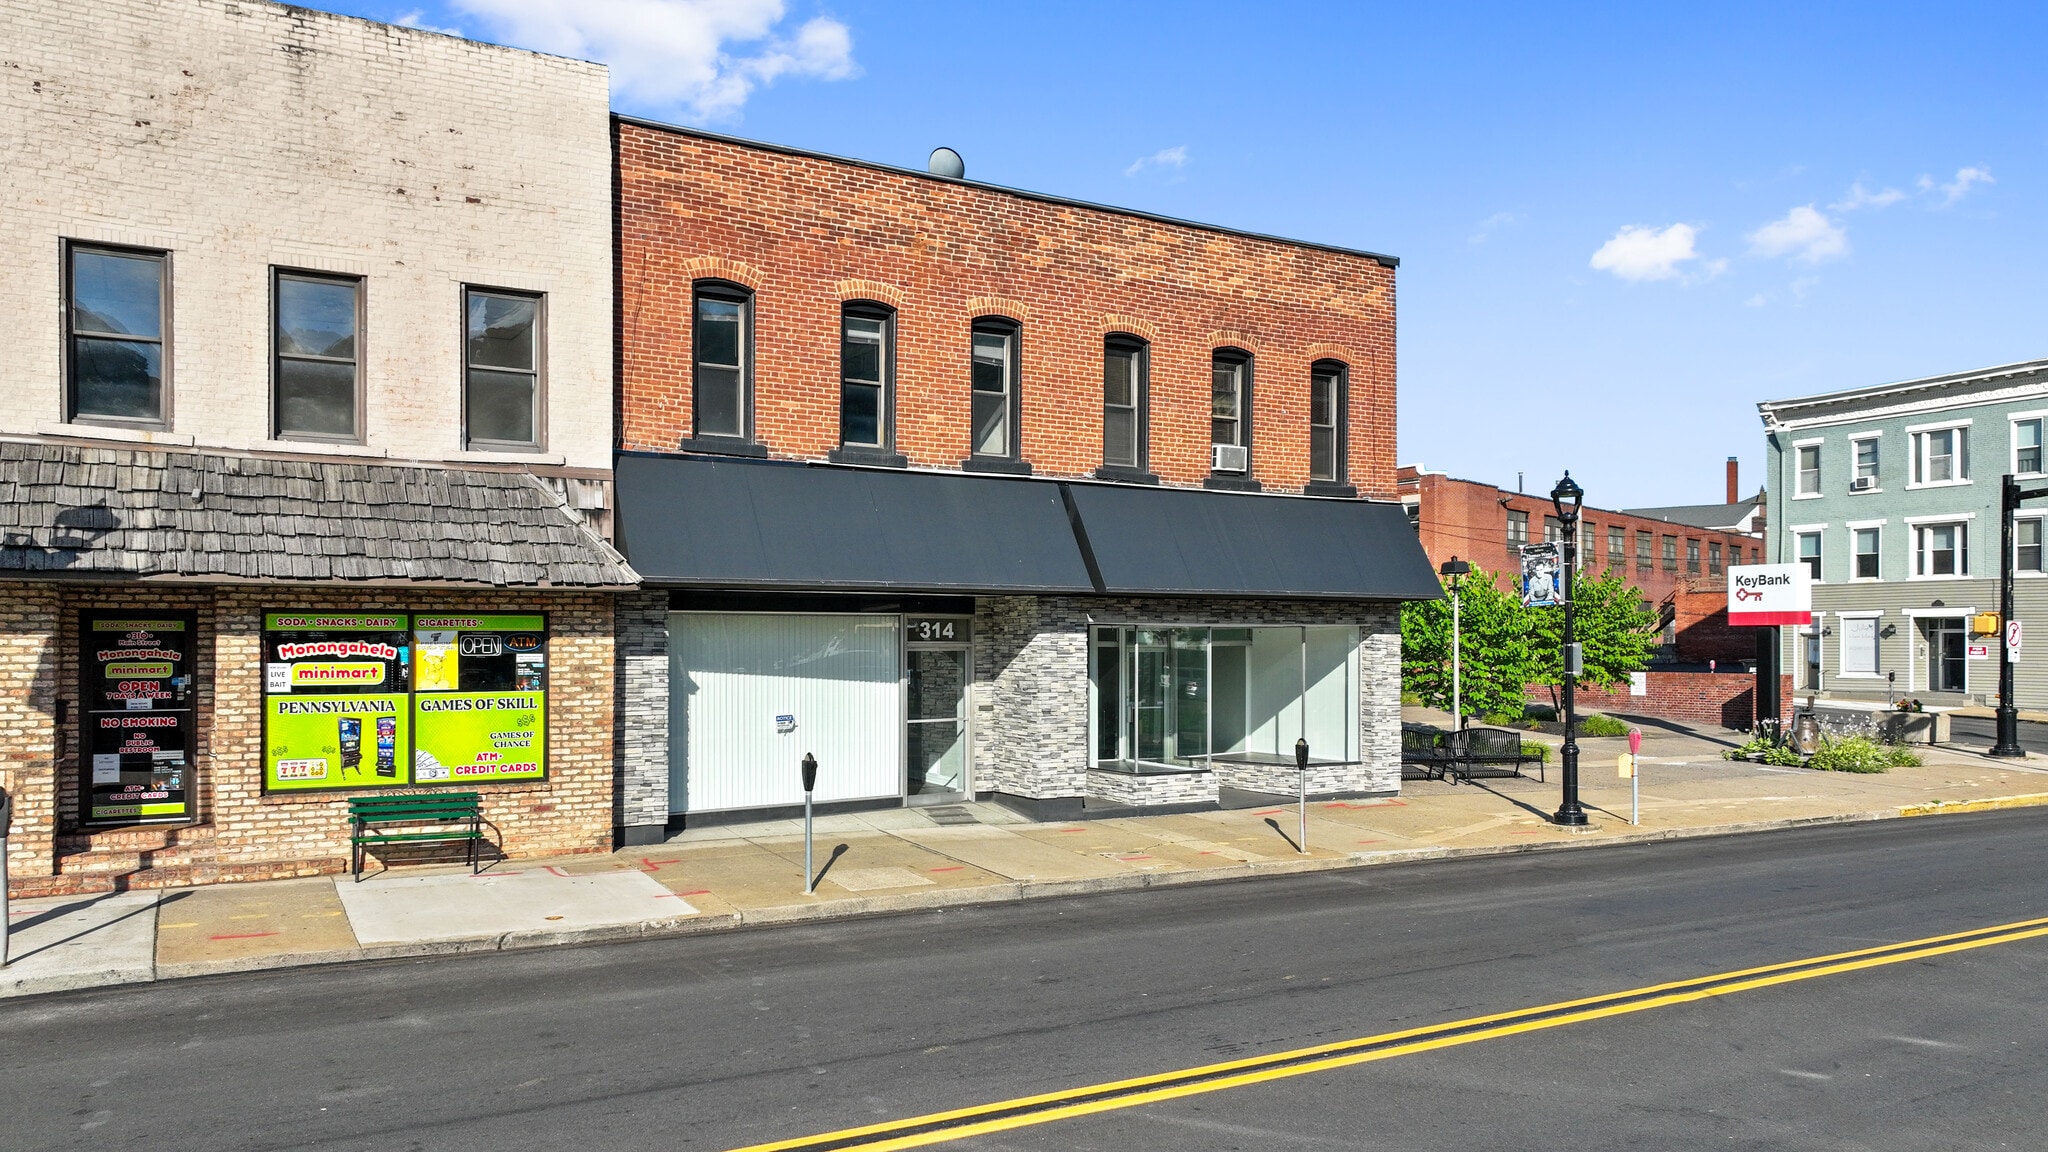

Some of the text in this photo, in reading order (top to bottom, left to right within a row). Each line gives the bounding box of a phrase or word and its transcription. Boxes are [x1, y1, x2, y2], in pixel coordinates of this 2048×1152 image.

[1736, 574, 1790, 588] KeyBank
[277, 618, 397, 626] SODA SNACKS DAIRY
[418, 619, 477, 627] CIGARETTES
[920, 622, 954, 638] 314
[131, 632, 148, 640] 310
[462, 638, 500, 654] OPEN
[509, 637, 536, 647] ATM
[98, 649, 181, 660] Monongahela
[280, 641, 395, 657] Monongahela
[111, 665, 168, 674] minimart
[299, 666, 378, 678] minimart
[118, 681, 160, 691] OPEN
[279, 700, 396, 714] PENNSYLVANIA
[420, 697, 538, 711] GAMES OF SKILL
[101, 717, 177, 728] NO SMOKING
[494, 740, 531, 748] CHANCE
[476, 752, 498, 762] ATM
[455, 763, 536, 775] CREDIT CARDS
